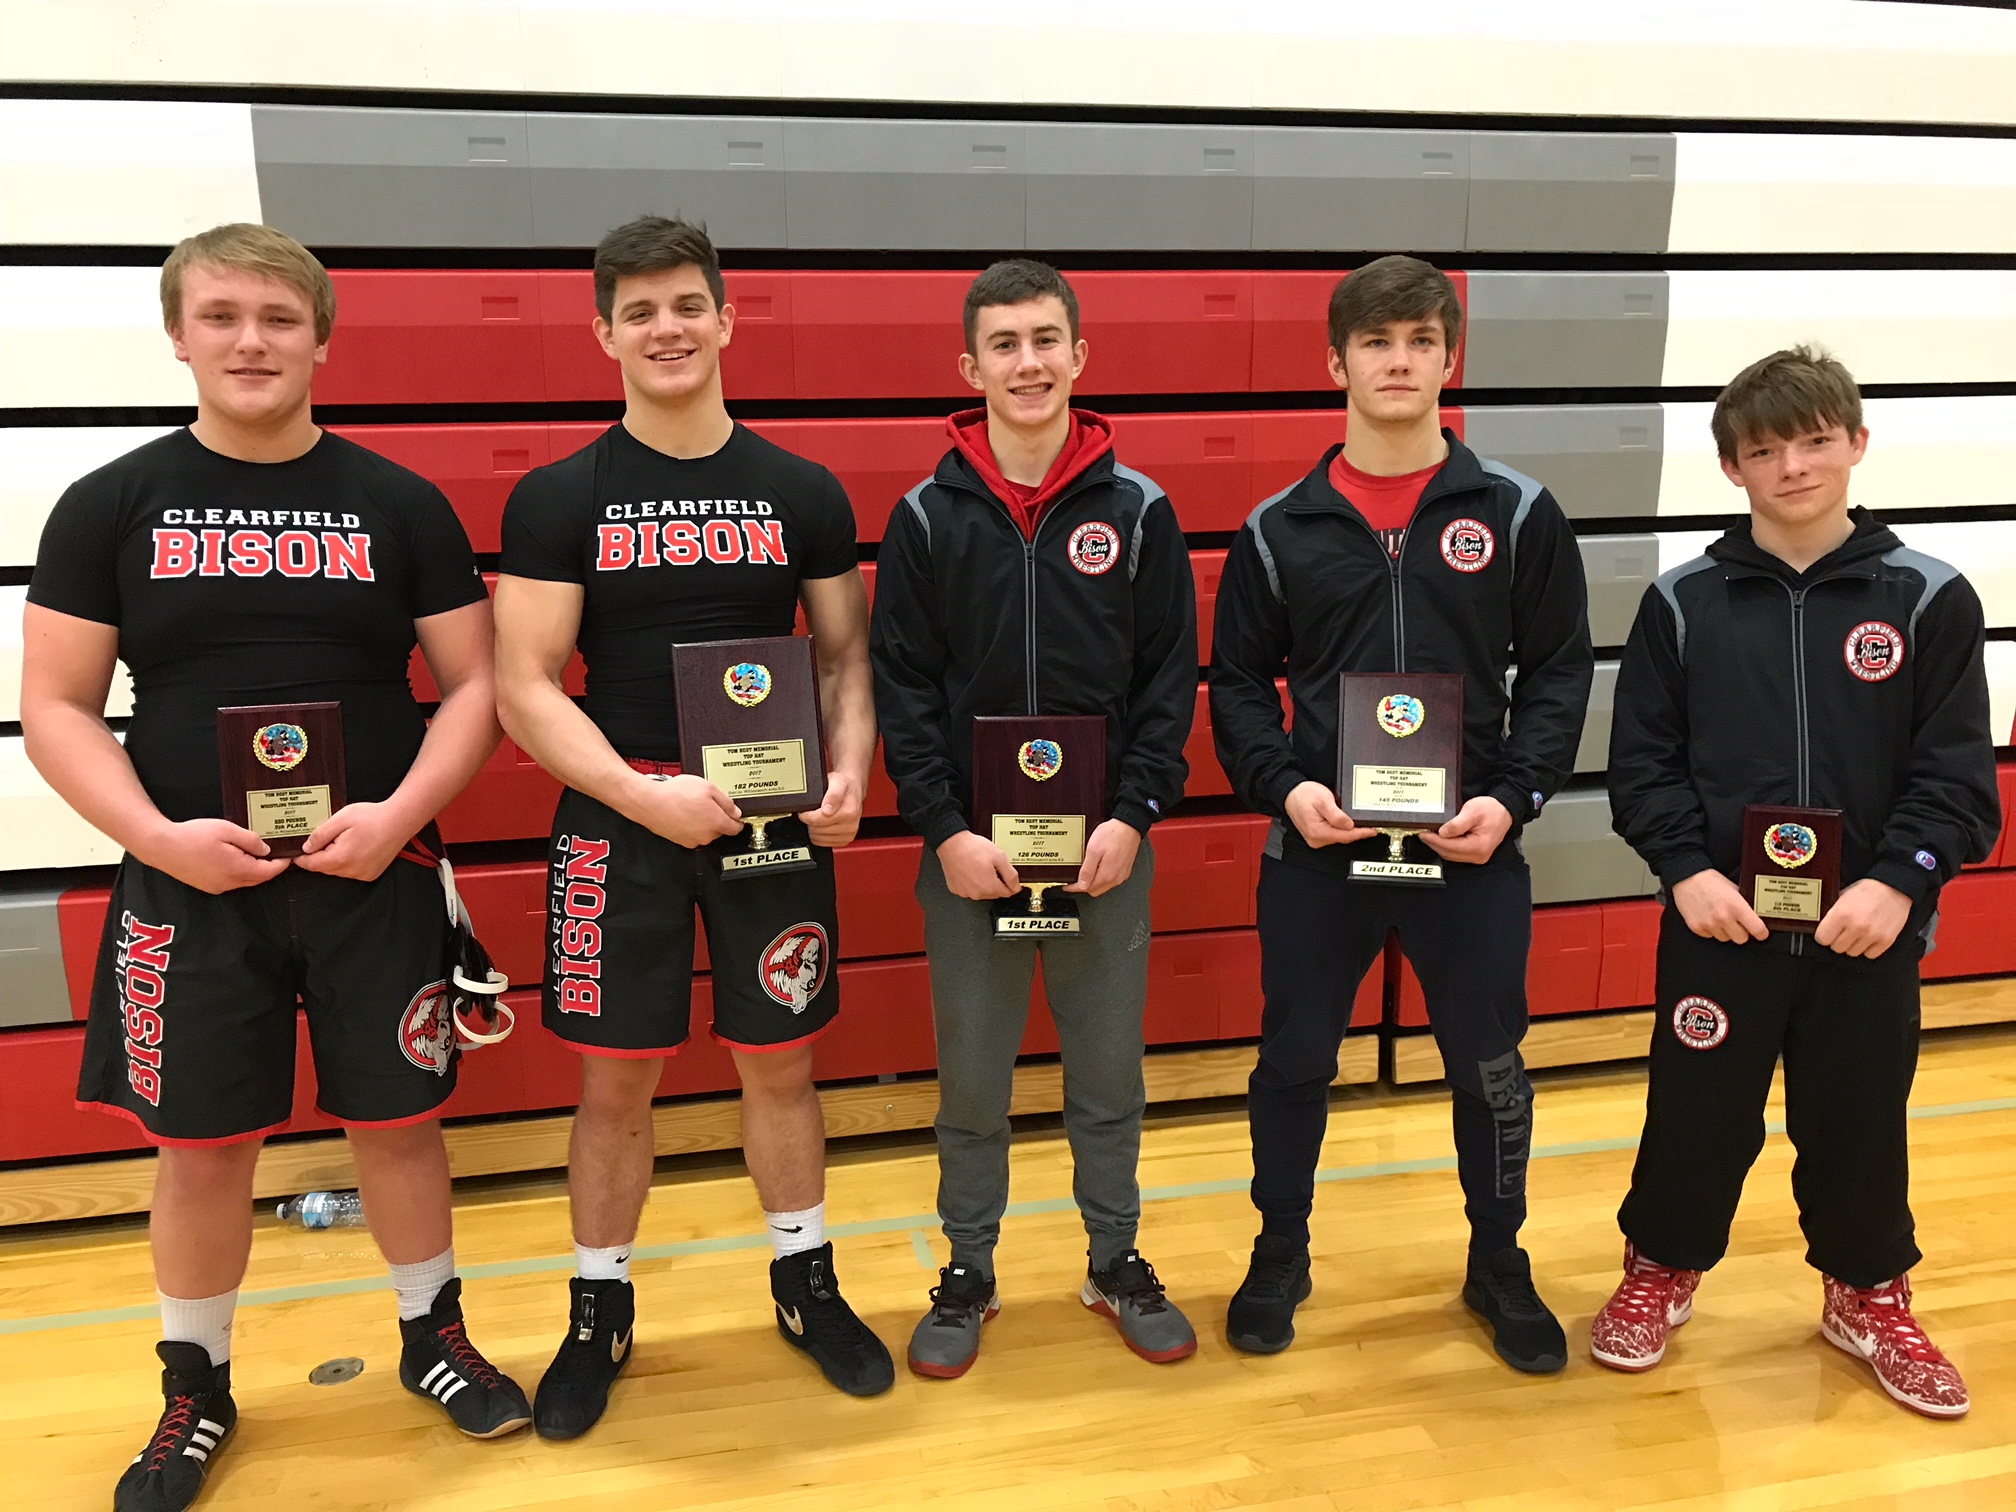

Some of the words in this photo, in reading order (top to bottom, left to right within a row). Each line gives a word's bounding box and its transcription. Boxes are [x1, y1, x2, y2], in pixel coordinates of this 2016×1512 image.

[163, 508, 361, 529] CLEARFIELD
[605, 499, 773, 520] CLEARFIELD
[1072, 524, 1118, 544] CLEARFIELD
[1445, 521, 1492, 544] CLEARFIELD
[596, 519, 789, 571] BISON
[1078, 540, 1109, 554] Bison
[1451, 537, 1483, 551] Bison
[150, 528, 376, 582] BISON
[1072, 553, 1115, 573] WRESTLING
[1445, 550, 1490, 571] WRESTLING
[1848, 624, 1901, 648] CLEARFIELD
[1857, 643, 1890, 658] Bison
[1850, 658, 1898, 680] WRESTLING
[752, 757, 786, 765] TOURNAMENT
[748, 780, 779, 788] POUNDS
[285, 816, 307, 824] POUNDS
[733, 856, 753, 866] 1st
[756, 850, 800, 864] PLACE
[1361, 864, 1386, 873] 2nd
[1388, 865, 1434, 876] PLACE
[560, 835, 610, 1016] BISON
[1007, 920, 1027, 929] 1st
[1029, 920, 1071, 929] PLACE
[125, 915, 175, 1107] BISON
[1682, 1012, 1716, 1029] Bison
